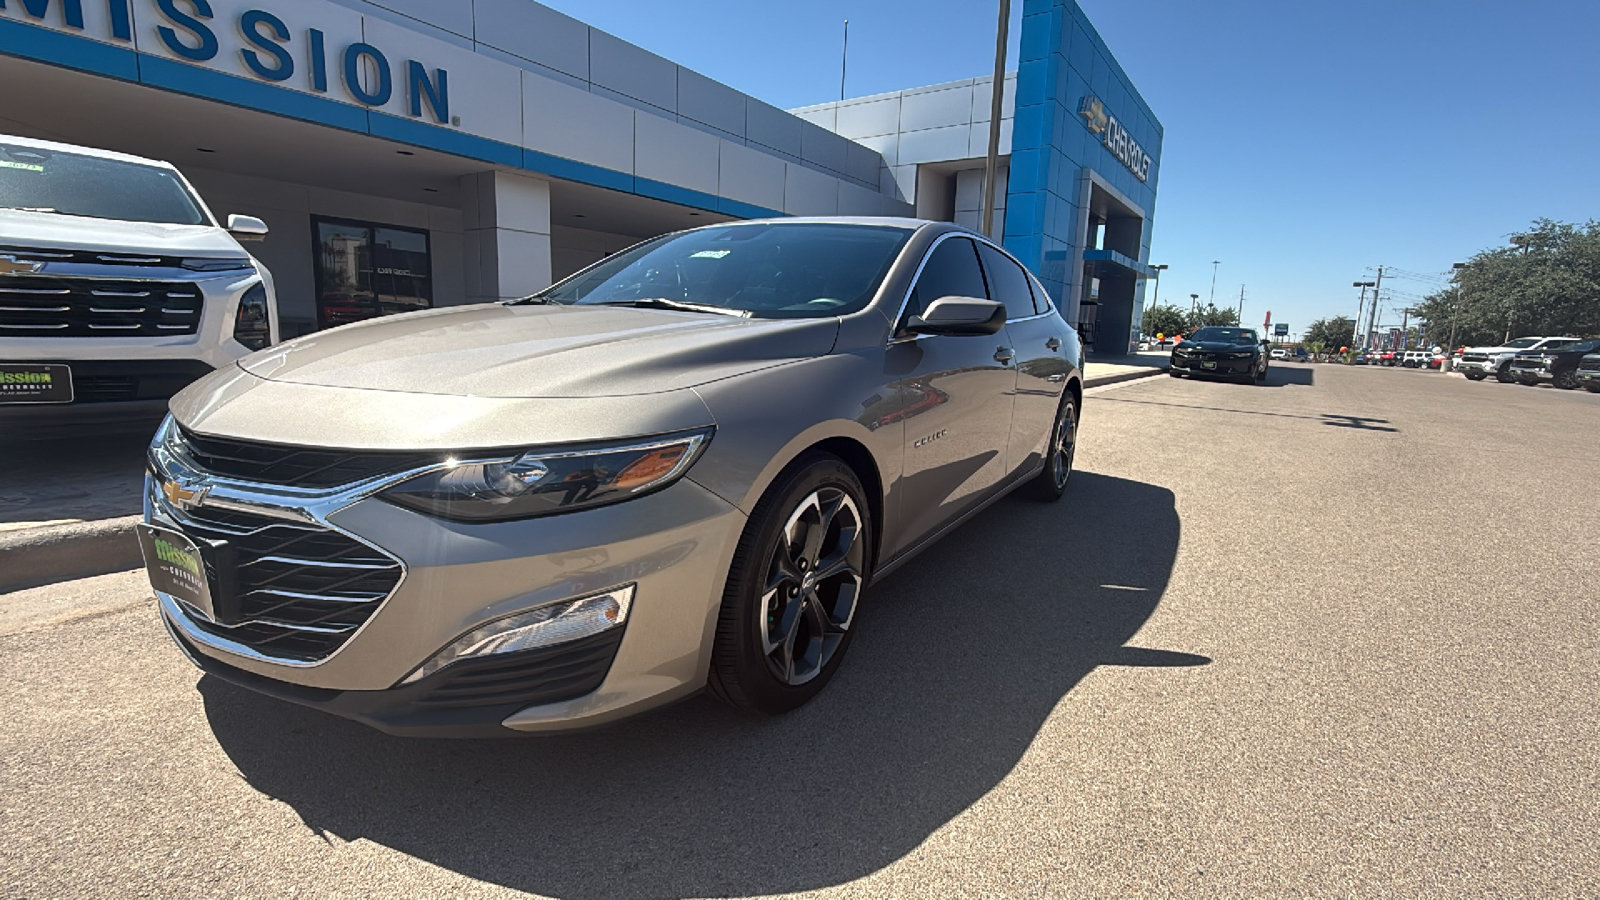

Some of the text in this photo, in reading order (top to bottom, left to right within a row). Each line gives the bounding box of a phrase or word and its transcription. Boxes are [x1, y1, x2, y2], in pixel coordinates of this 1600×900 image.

[0, 0, 449, 124] ISSION
[1106, 115, 1151, 183] CHEVROLET
[0, 371, 52, 384] ission
